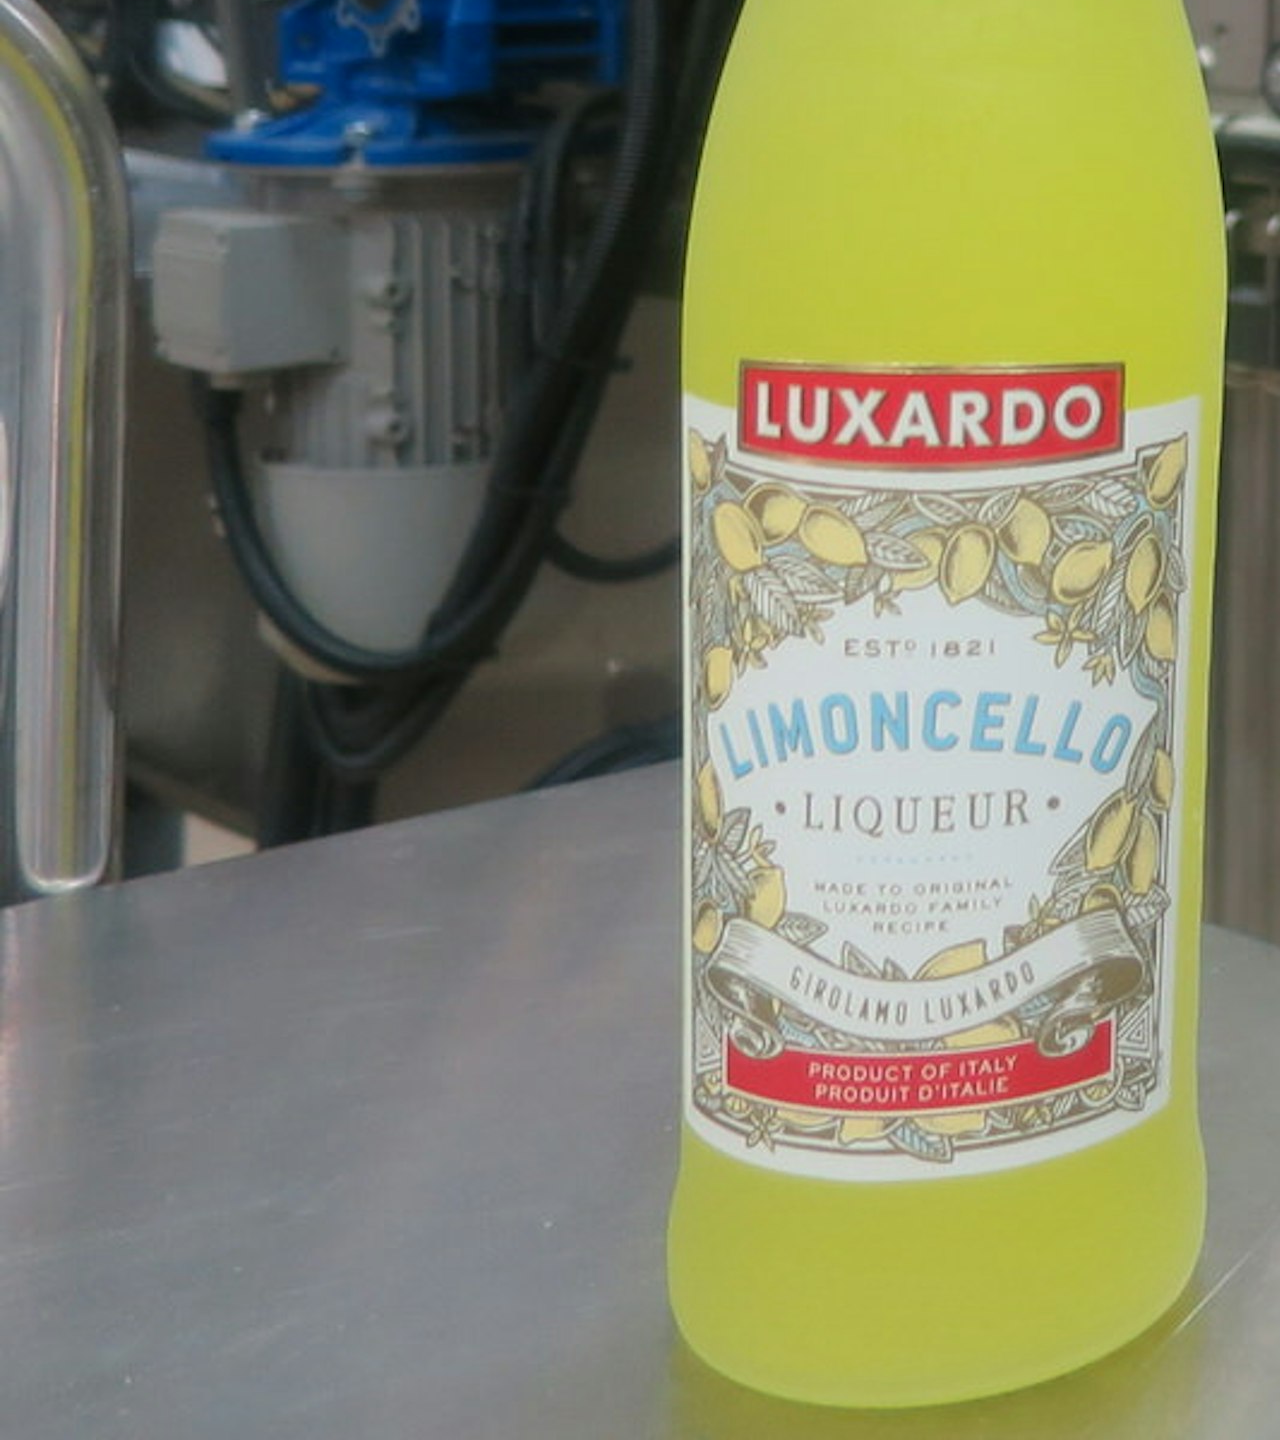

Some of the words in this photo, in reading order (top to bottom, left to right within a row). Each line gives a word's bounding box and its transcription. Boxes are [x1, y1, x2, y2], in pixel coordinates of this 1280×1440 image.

[755, 380, 1105, 449] LUXARDO
[929, 638, 997, 657] 1821
[717, 689, 1134, 781] LIMONCELLO
[804, 789, 1031, 839] LIQUEUR
[813, 881, 869, 898] MADE
[876, 880, 904, 898] TO
[914, 875, 1014, 896] ORIGINAL
[822, 900, 919, 916] LUXARDO
[928, 896, 1003, 914] FAMILY
[872, 919, 949, 934] RECIPE
[789, 964, 910, 1027] GIROLAMO
[923, 962, 1036, 1025] LUXARDO
[807, 1060, 912, 1083] PRODUCT
[921, 1059, 952, 1082] OF
[958, 1055, 1018, 1079] ITALY
[814, 1083, 912, 1104] PRODUIT
[917, 1078, 1010, 1102] D'ITALIE
